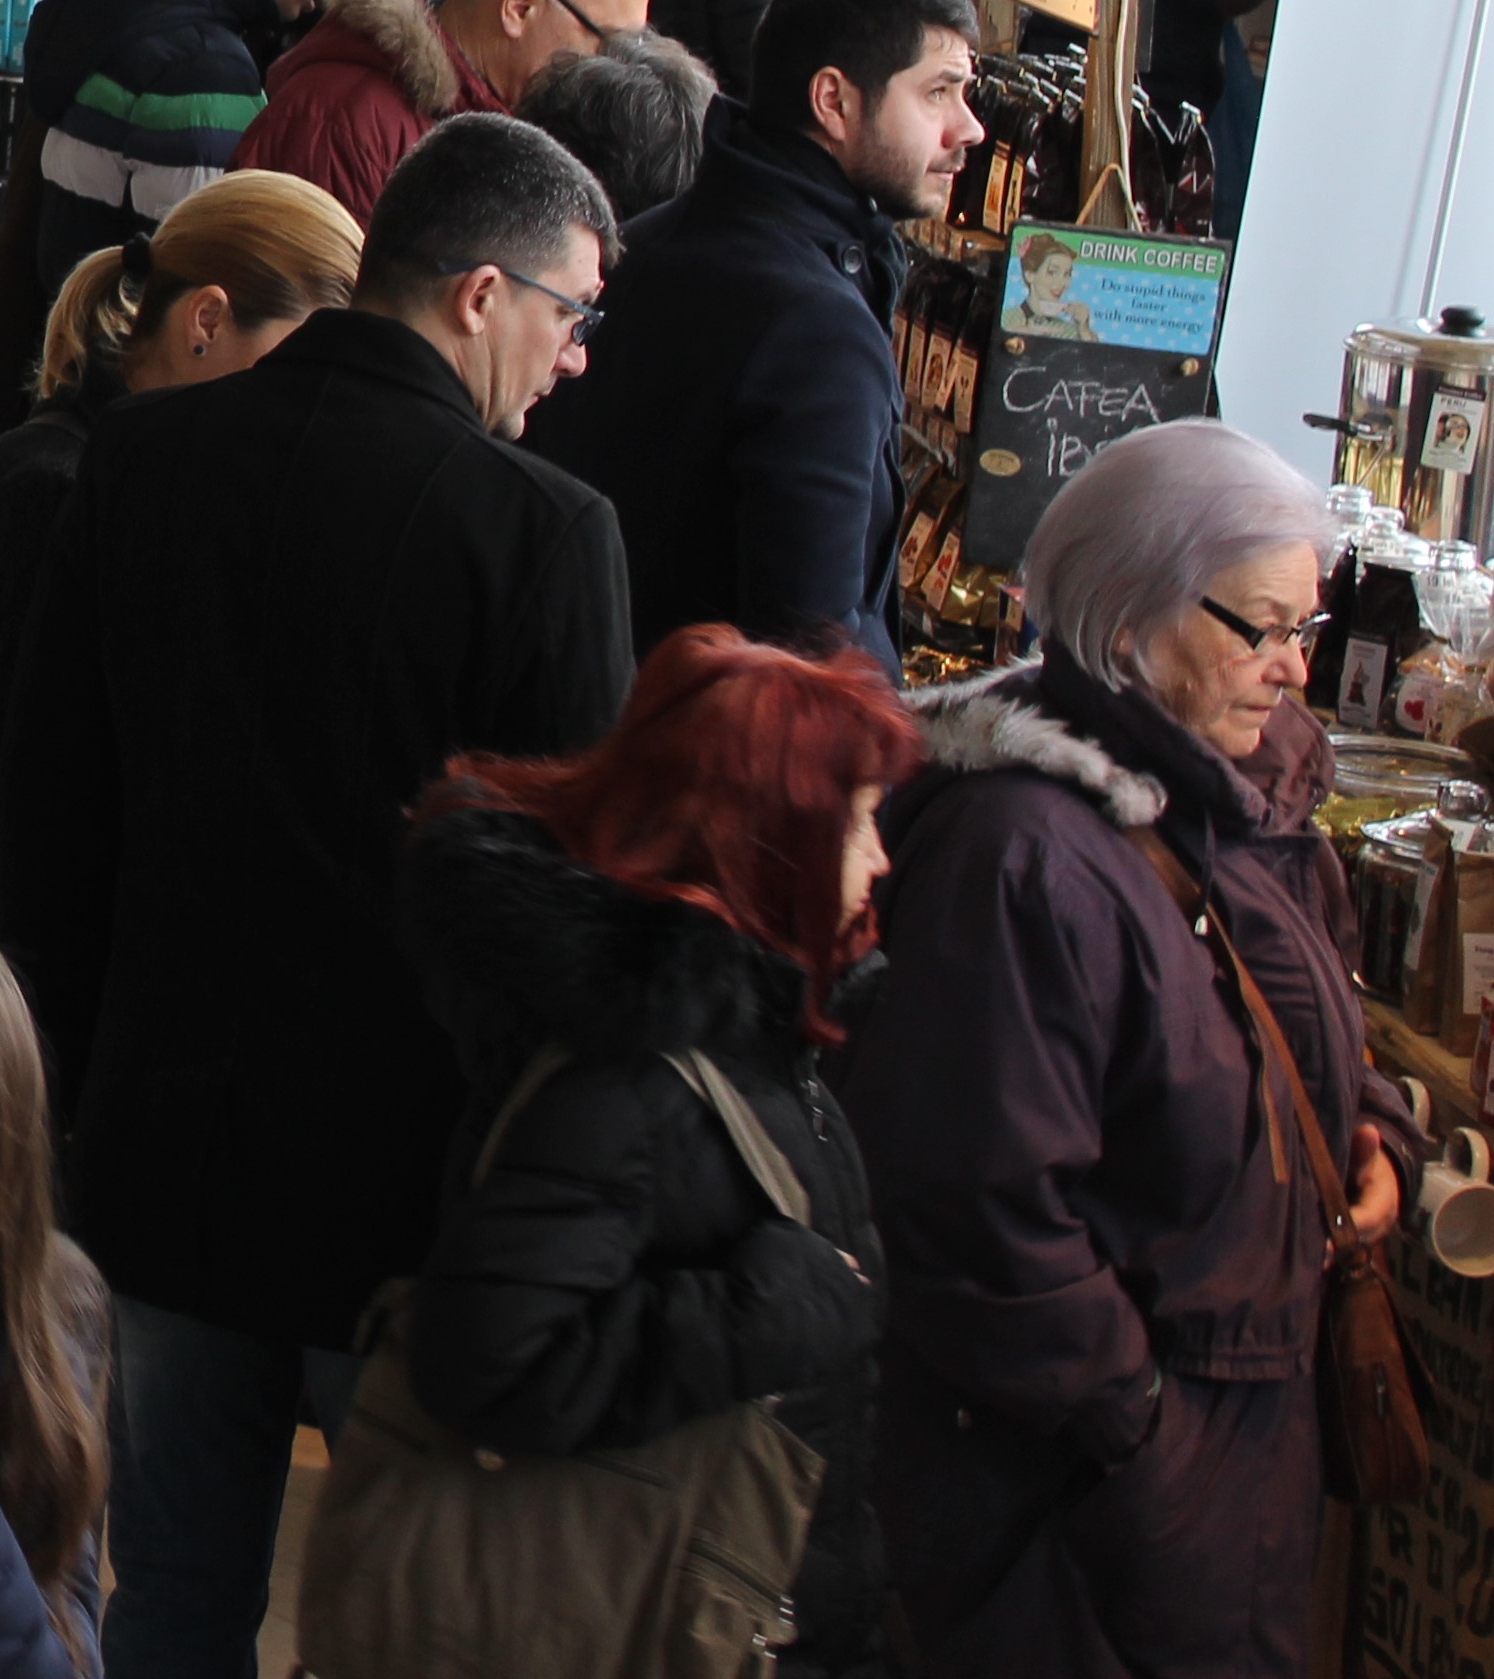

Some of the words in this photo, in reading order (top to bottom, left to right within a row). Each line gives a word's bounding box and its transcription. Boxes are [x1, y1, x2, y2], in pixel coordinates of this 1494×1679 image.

[1080, 240, 1139, 265] DRINK
[1143, 249, 1218, 274] COFFEE
[1101, 278, 1122, 291] Do
[1124, 283, 1164, 297] stupid
[1167, 286, 1206, 304] things
[1131, 298, 1167, 312] faster
[1094, 307, 1122, 321] with
[1125, 314, 1157, 326] more
[1160, 318, 1204, 335] energy
